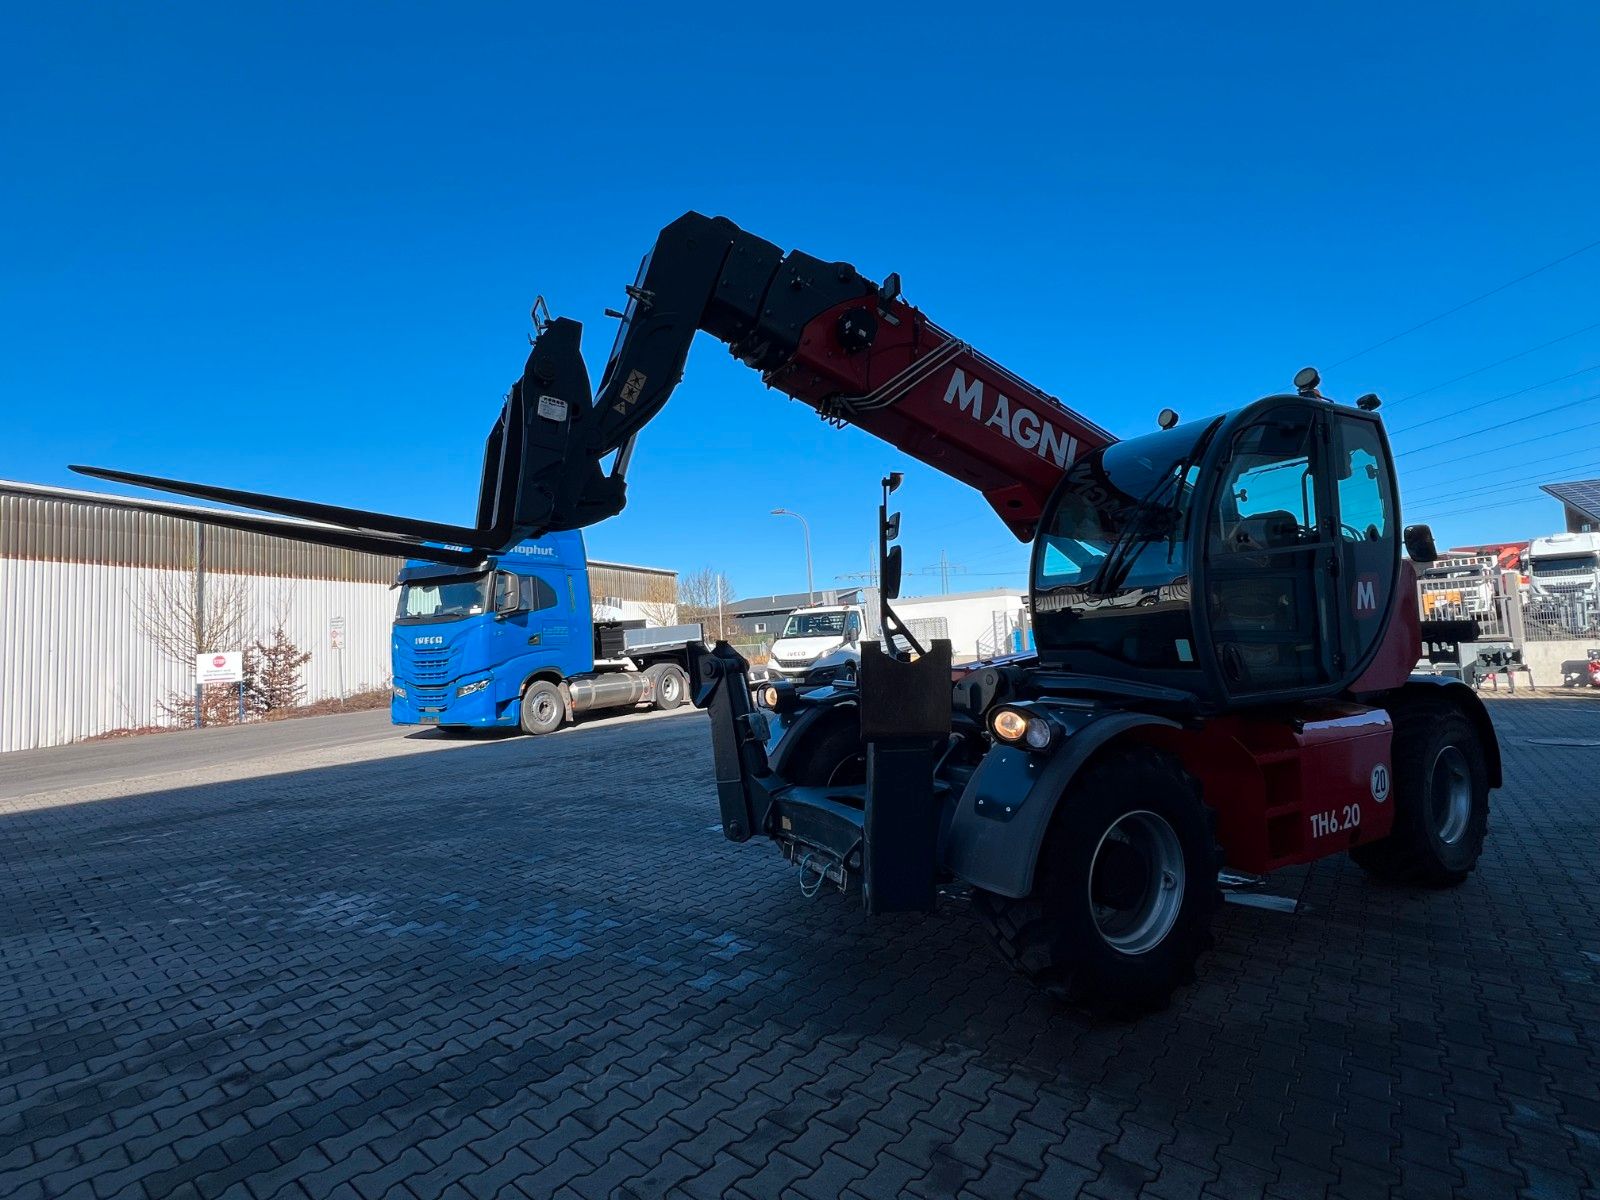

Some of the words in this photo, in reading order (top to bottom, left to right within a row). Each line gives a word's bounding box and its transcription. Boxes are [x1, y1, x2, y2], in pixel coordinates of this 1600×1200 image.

[943, 367, 1078, 471] MAGNI
[1357, 581, 1376, 610] M
[415, 636, 443, 645] IVECO
[1374, 769, 1386, 793] 20
[1310, 803, 1360, 838] TH6.20
